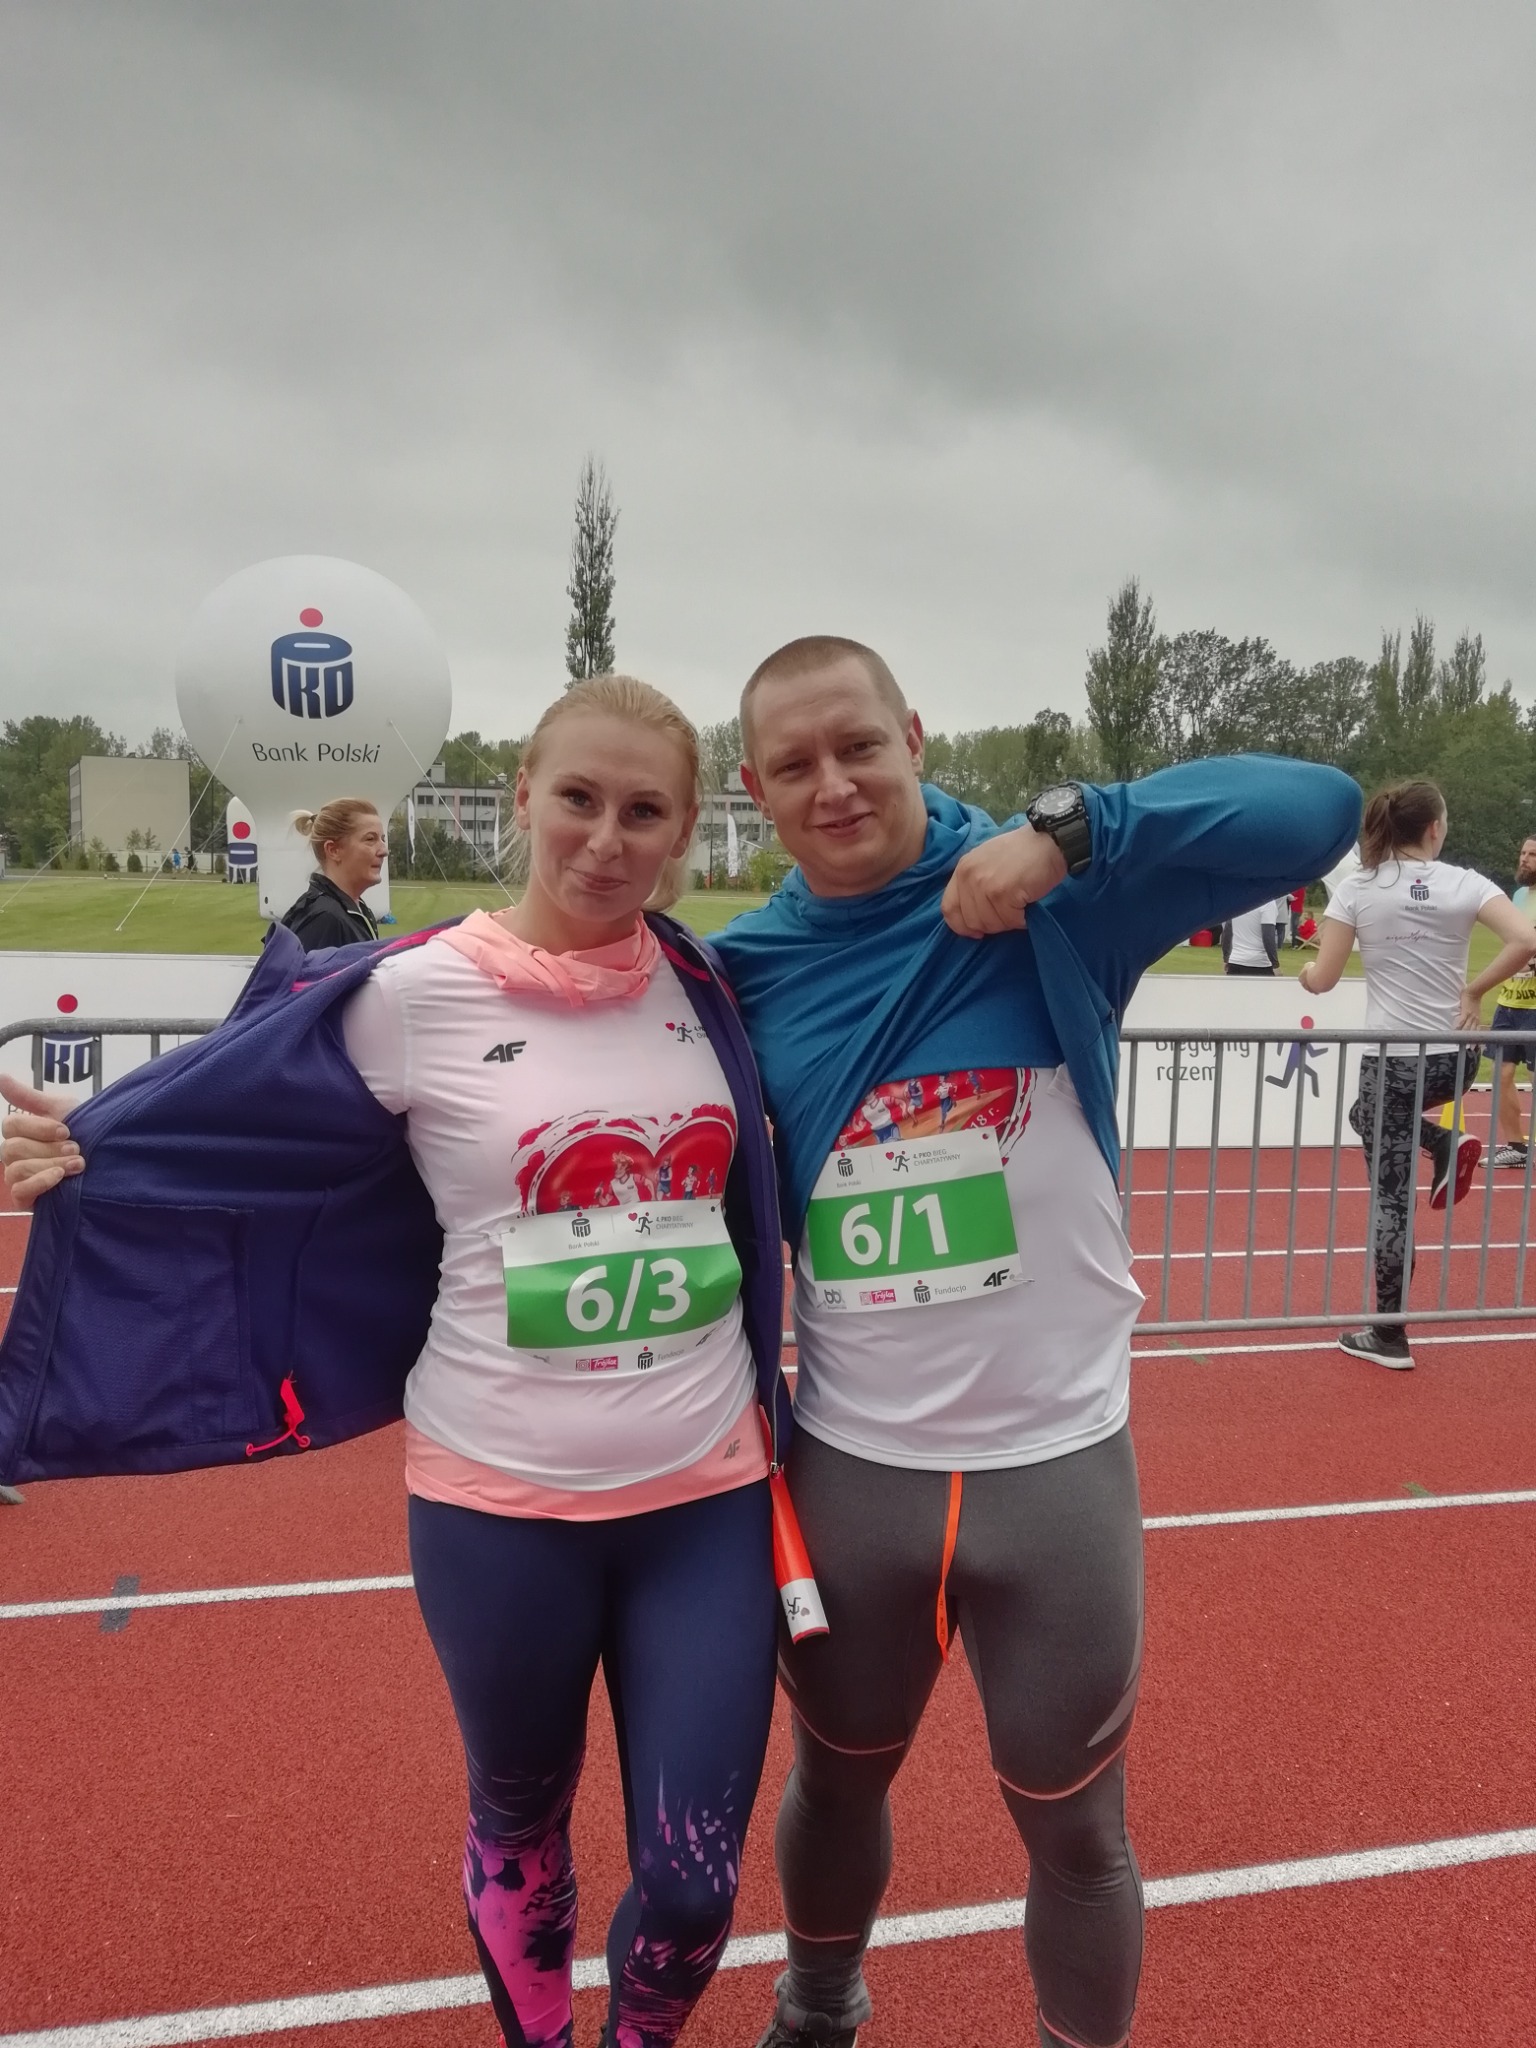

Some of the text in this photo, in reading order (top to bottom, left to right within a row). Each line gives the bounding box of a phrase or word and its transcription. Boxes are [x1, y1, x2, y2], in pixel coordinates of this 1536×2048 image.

[270, 631, 354, 720] PKO
[252, 742, 381, 763] Bank Polski
[483, 1040, 527, 1063] 4F
[913, 1154, 961, 1167] CHARYTATYWNY
[841, 1193, 950, 1266] 6/1
[983, 1268, 1010, 1287] 4F
[566, 1257, 691, 1332] 6/3
[934, 1284, 967, 1296] Fundacja
